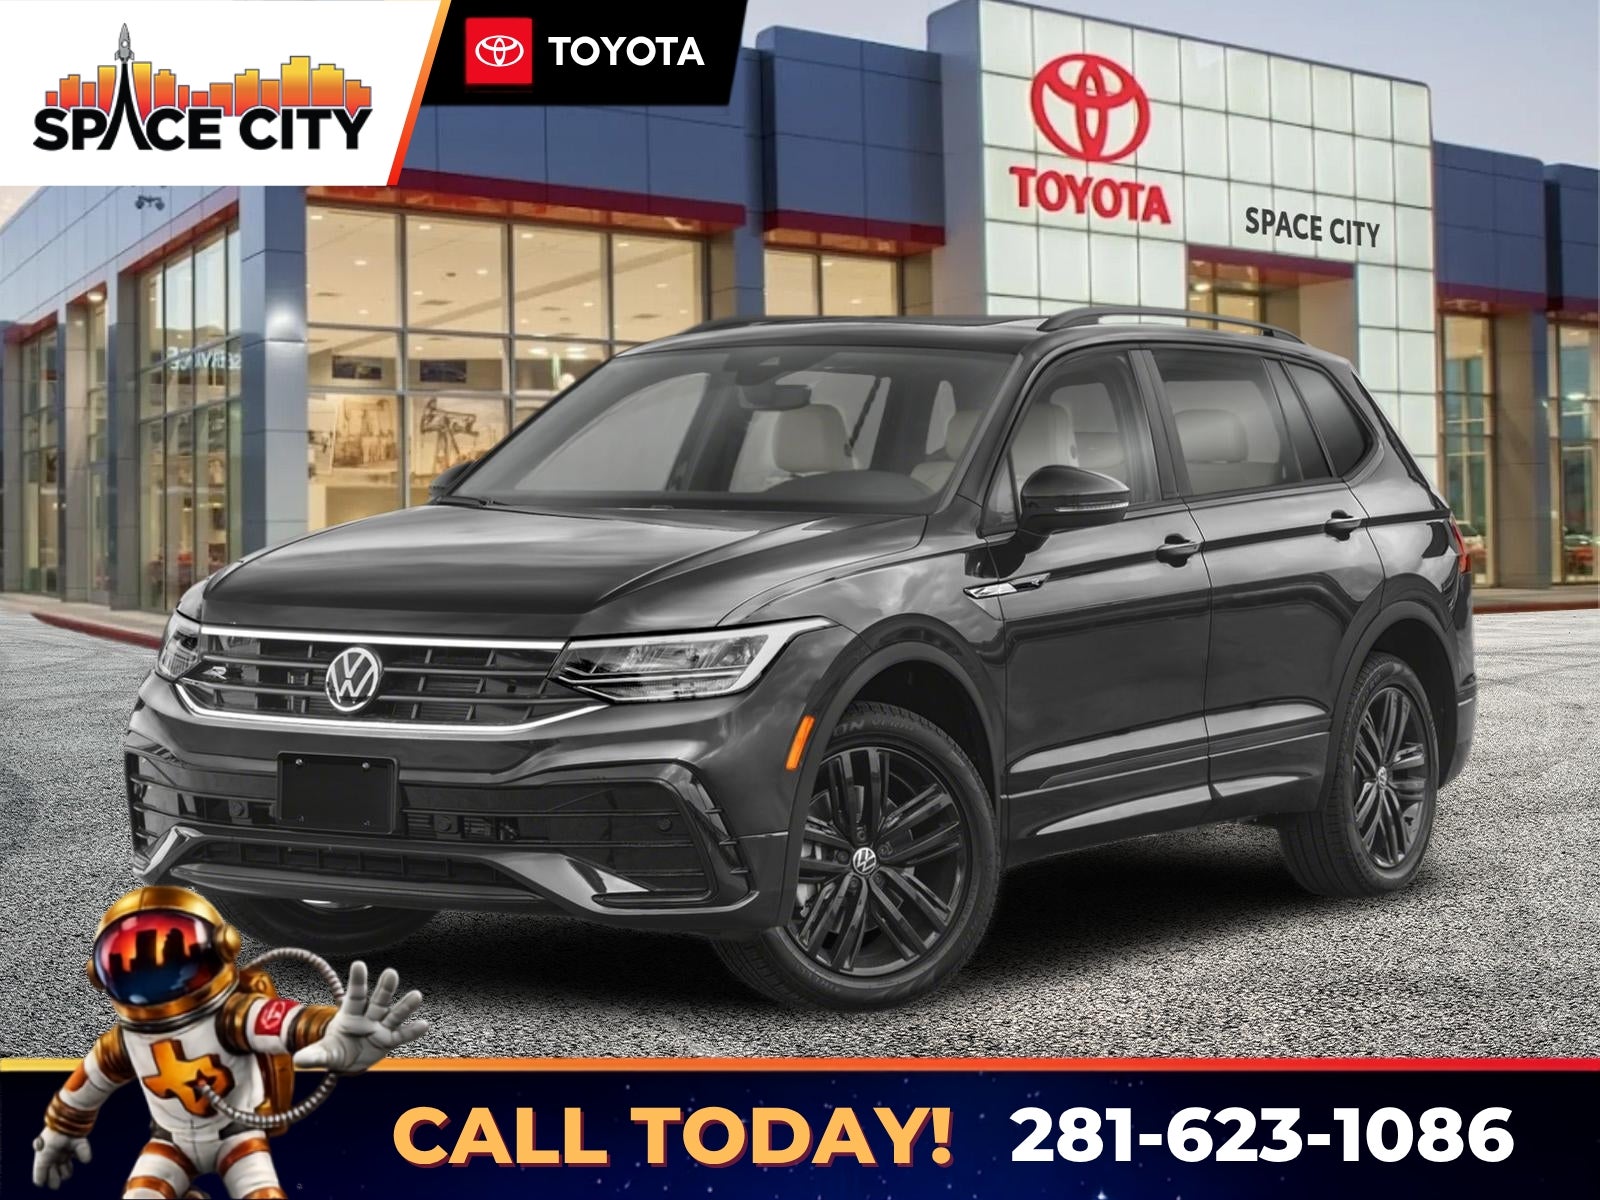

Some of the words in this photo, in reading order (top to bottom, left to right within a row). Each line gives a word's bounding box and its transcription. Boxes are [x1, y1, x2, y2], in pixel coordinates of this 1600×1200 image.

[1009, 166, 1171, 224] TOYOTA
[1245, 206, 1323, 242] SPACE
[1329, 218, 1380, 248] CITY
